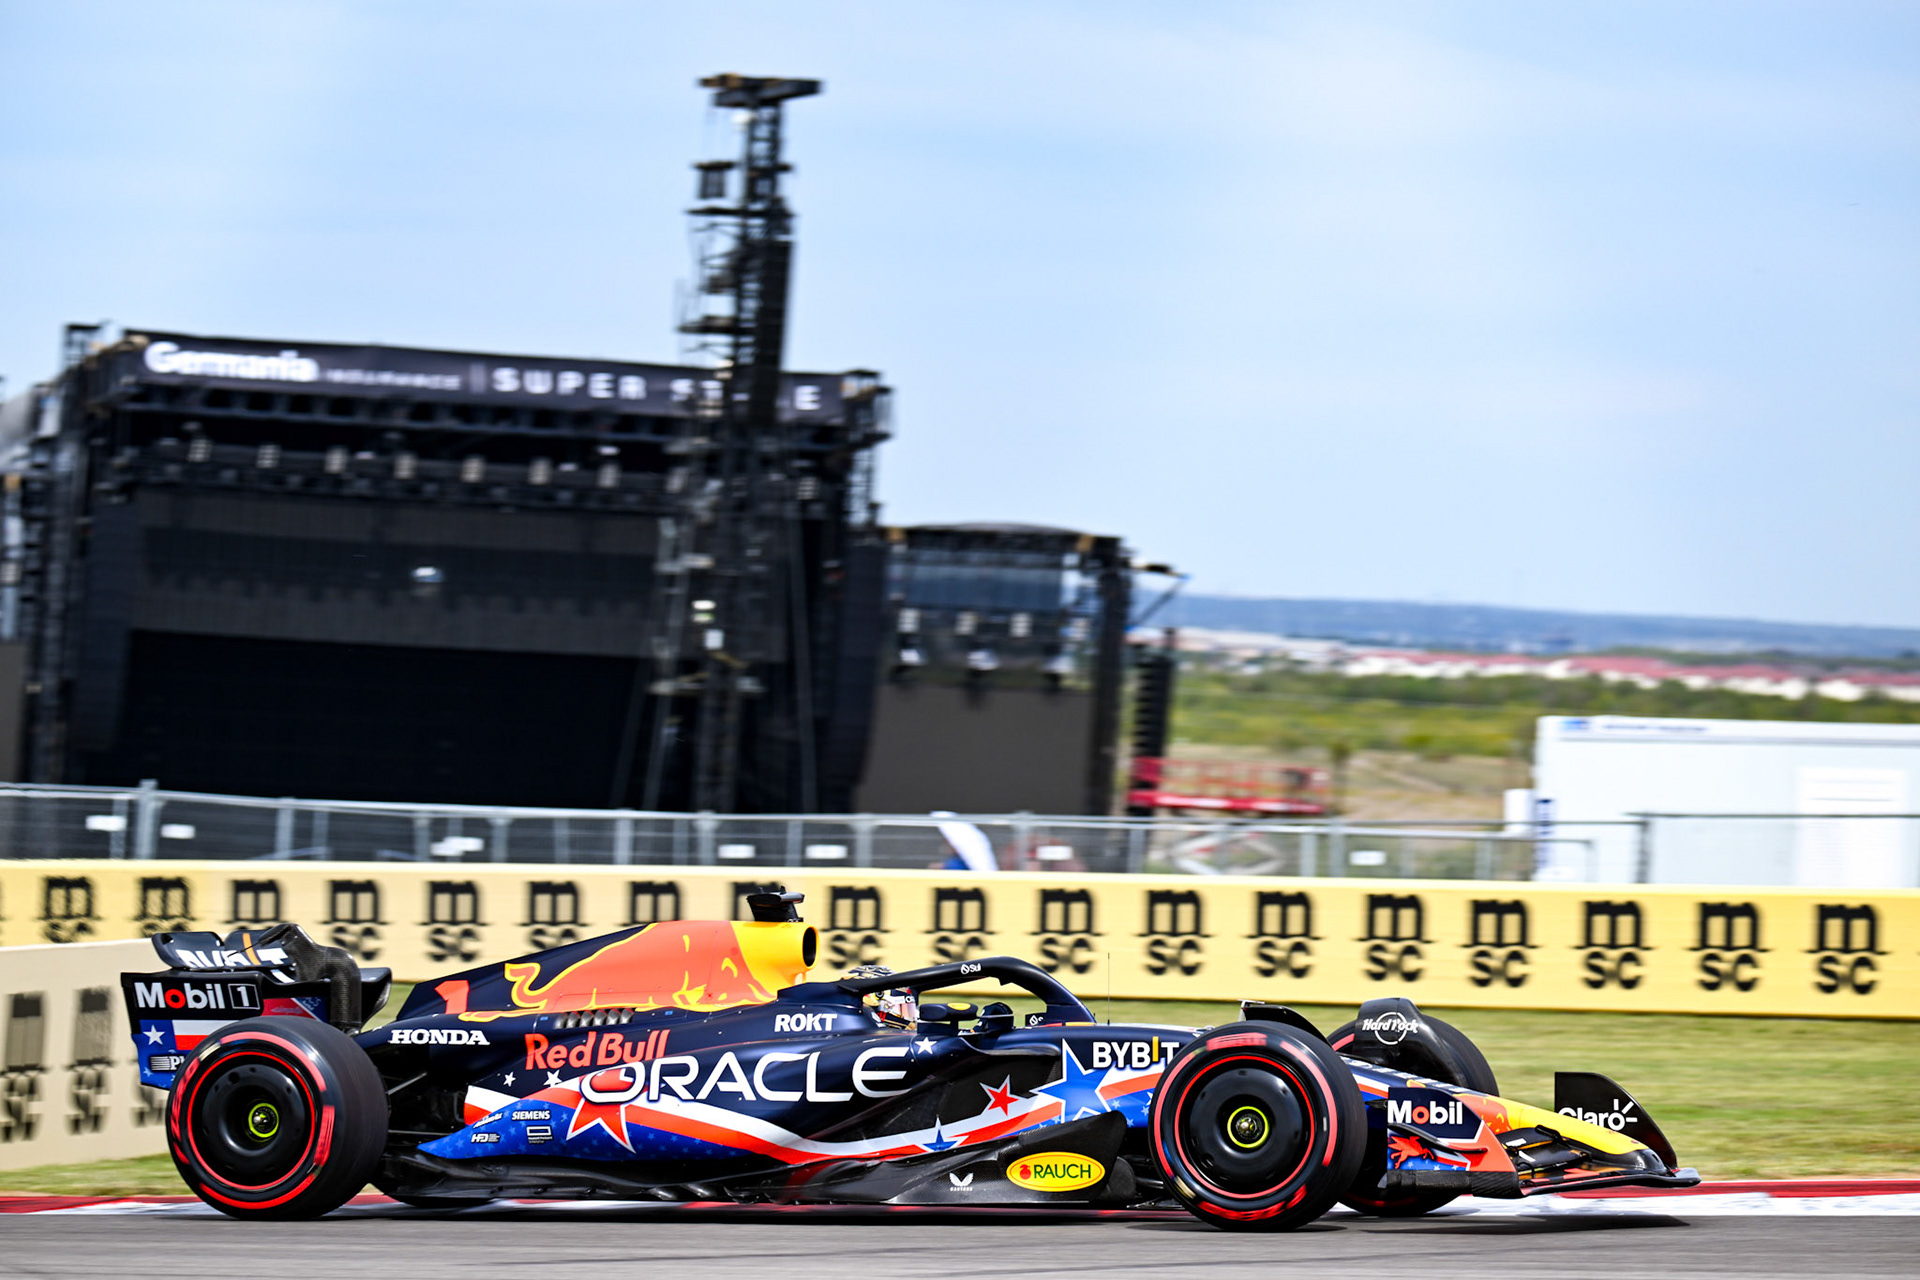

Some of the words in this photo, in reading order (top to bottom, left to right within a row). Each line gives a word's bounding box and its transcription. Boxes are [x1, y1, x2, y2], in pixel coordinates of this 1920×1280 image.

[492, 367, 647, 400] SUPER
[670, 377, 821, 411] STE
[134, 982, 226, 1010] Mobil
[236, 986, 250, 1007] 1
[435, 980, 470, 1014] 1
[775, 1013, 838, 1033] ROKT
[389, 1029, 490, 1046] HONDA
[525, 1031, 597, 1070] Red
[596, 1029, 671, 1066] Bull
[1093, 1036, 1180, 1068] BYBIT
[580, 1046, 914, 1104] ORACLE
[511, 1110, 551, 1121] SIEMENS
[1387, 1101, 1463, 1125] Mobil
[1033, 1164, 1091, 1179] RAUCH
